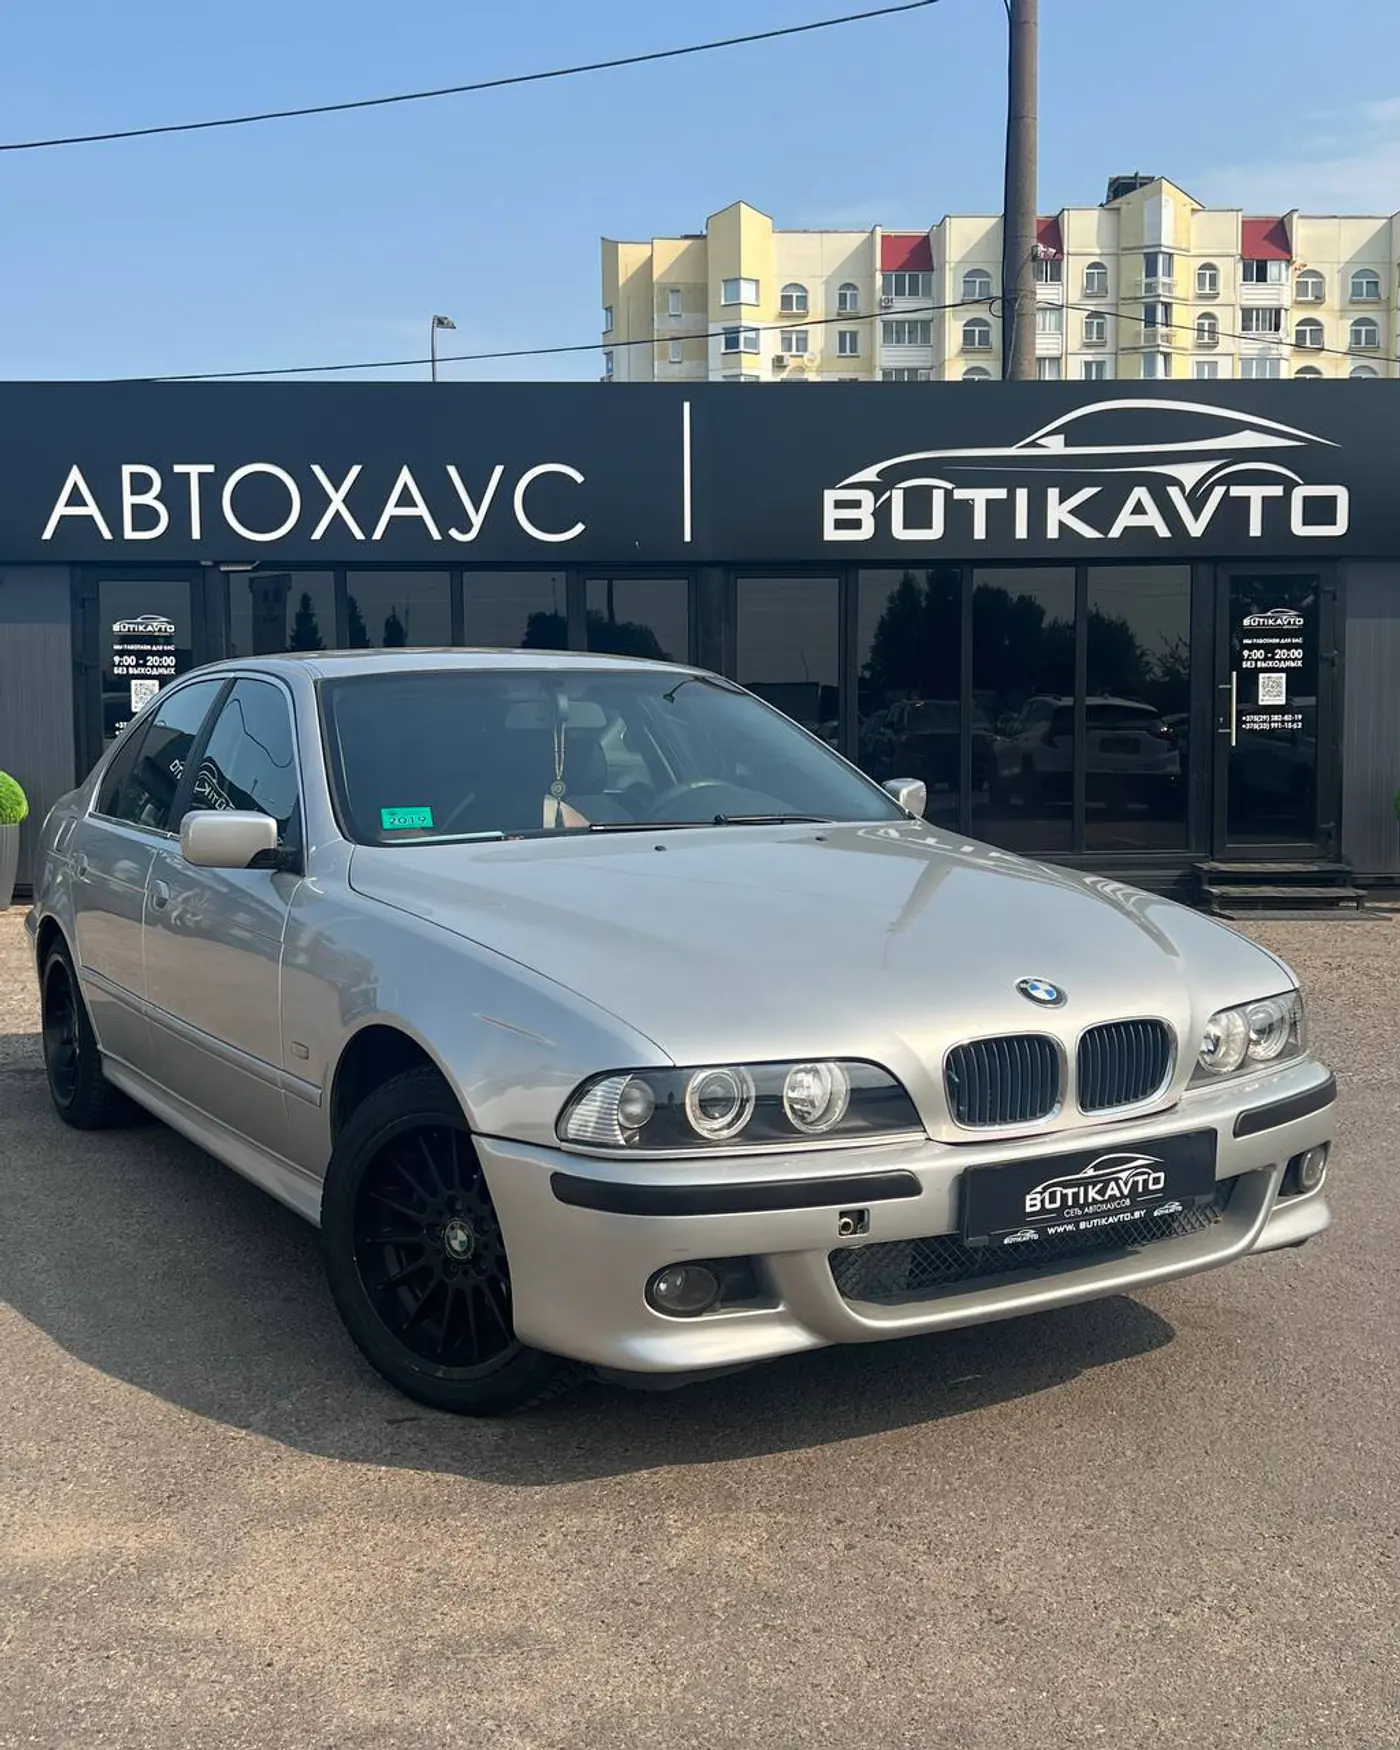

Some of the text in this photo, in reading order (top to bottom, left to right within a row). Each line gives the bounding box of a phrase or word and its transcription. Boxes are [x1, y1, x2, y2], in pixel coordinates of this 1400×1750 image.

[41, 462, 587, 544] АВТОХАУС
[822, 483, 1350, 542] BUTIKAVTO
[112, 624, 175, 632] BUTIKAVTO
[1242, 617, 1304, 626] BUTIKAVTO
[113, 655, 136, 666] 9:00
[146, 656, 176, 666] 20:00
[1242, 649, 1265, 660] 9:00
[1274, 648, 1303, 659] 20:00
[1242, 660, 1303, 668] БЕЗ ВЫХОДНЫХ
[1025, 1172, 1165, 1212] BUTIKAVTO
[1064, 1198, 1131, 1218] СЕТЬ АВТОХАУСОВ
[1079, 1209, 1146, 1229] BUTIKAVTO.BY
